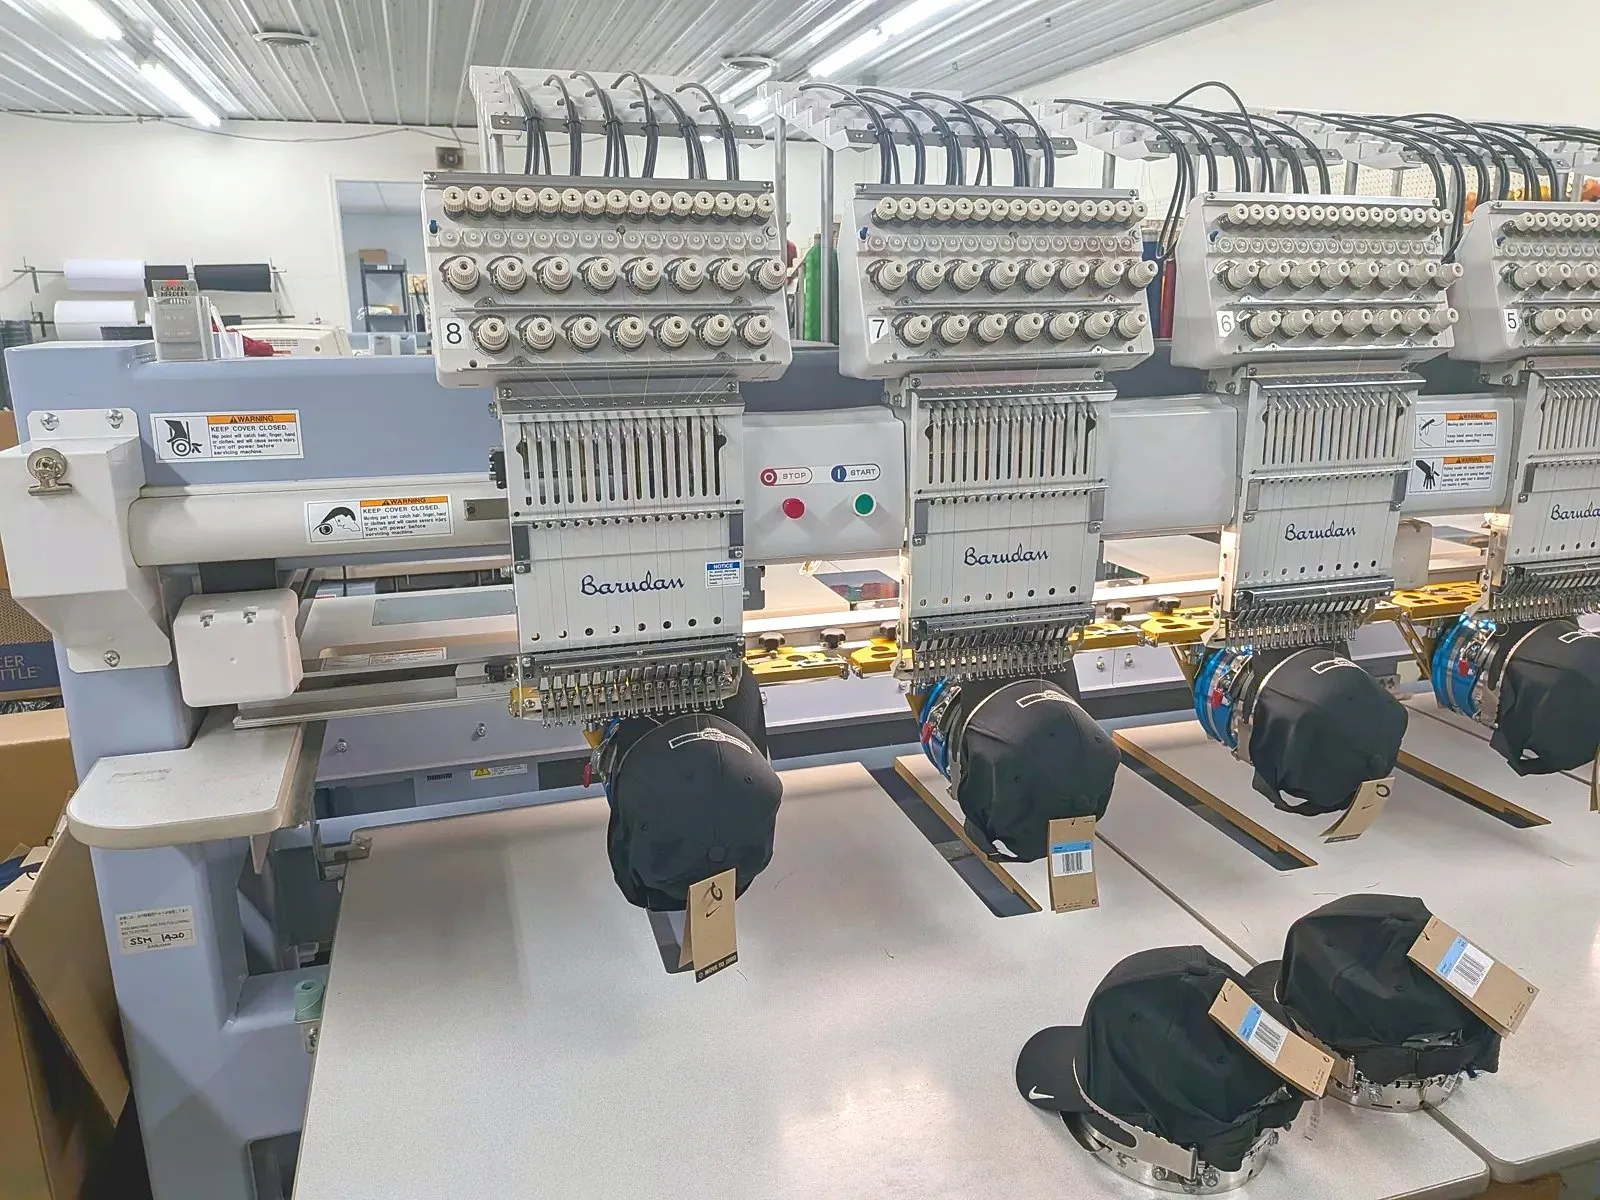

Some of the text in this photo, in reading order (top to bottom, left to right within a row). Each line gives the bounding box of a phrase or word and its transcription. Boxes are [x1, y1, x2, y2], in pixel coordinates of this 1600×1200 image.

[872, 320, 884, 338] 7
[1222, 314, 1232, 332] 6
[1508, 312, 1516, 328] 5
[446, 322, 462, 344] 8
[389, 497, 426, 505] WARNING
[1284, 520, 1356, 541] Barudan
[964, 542, 1049, 566] Barudan
[581, 570, 684, 596] Barudan
